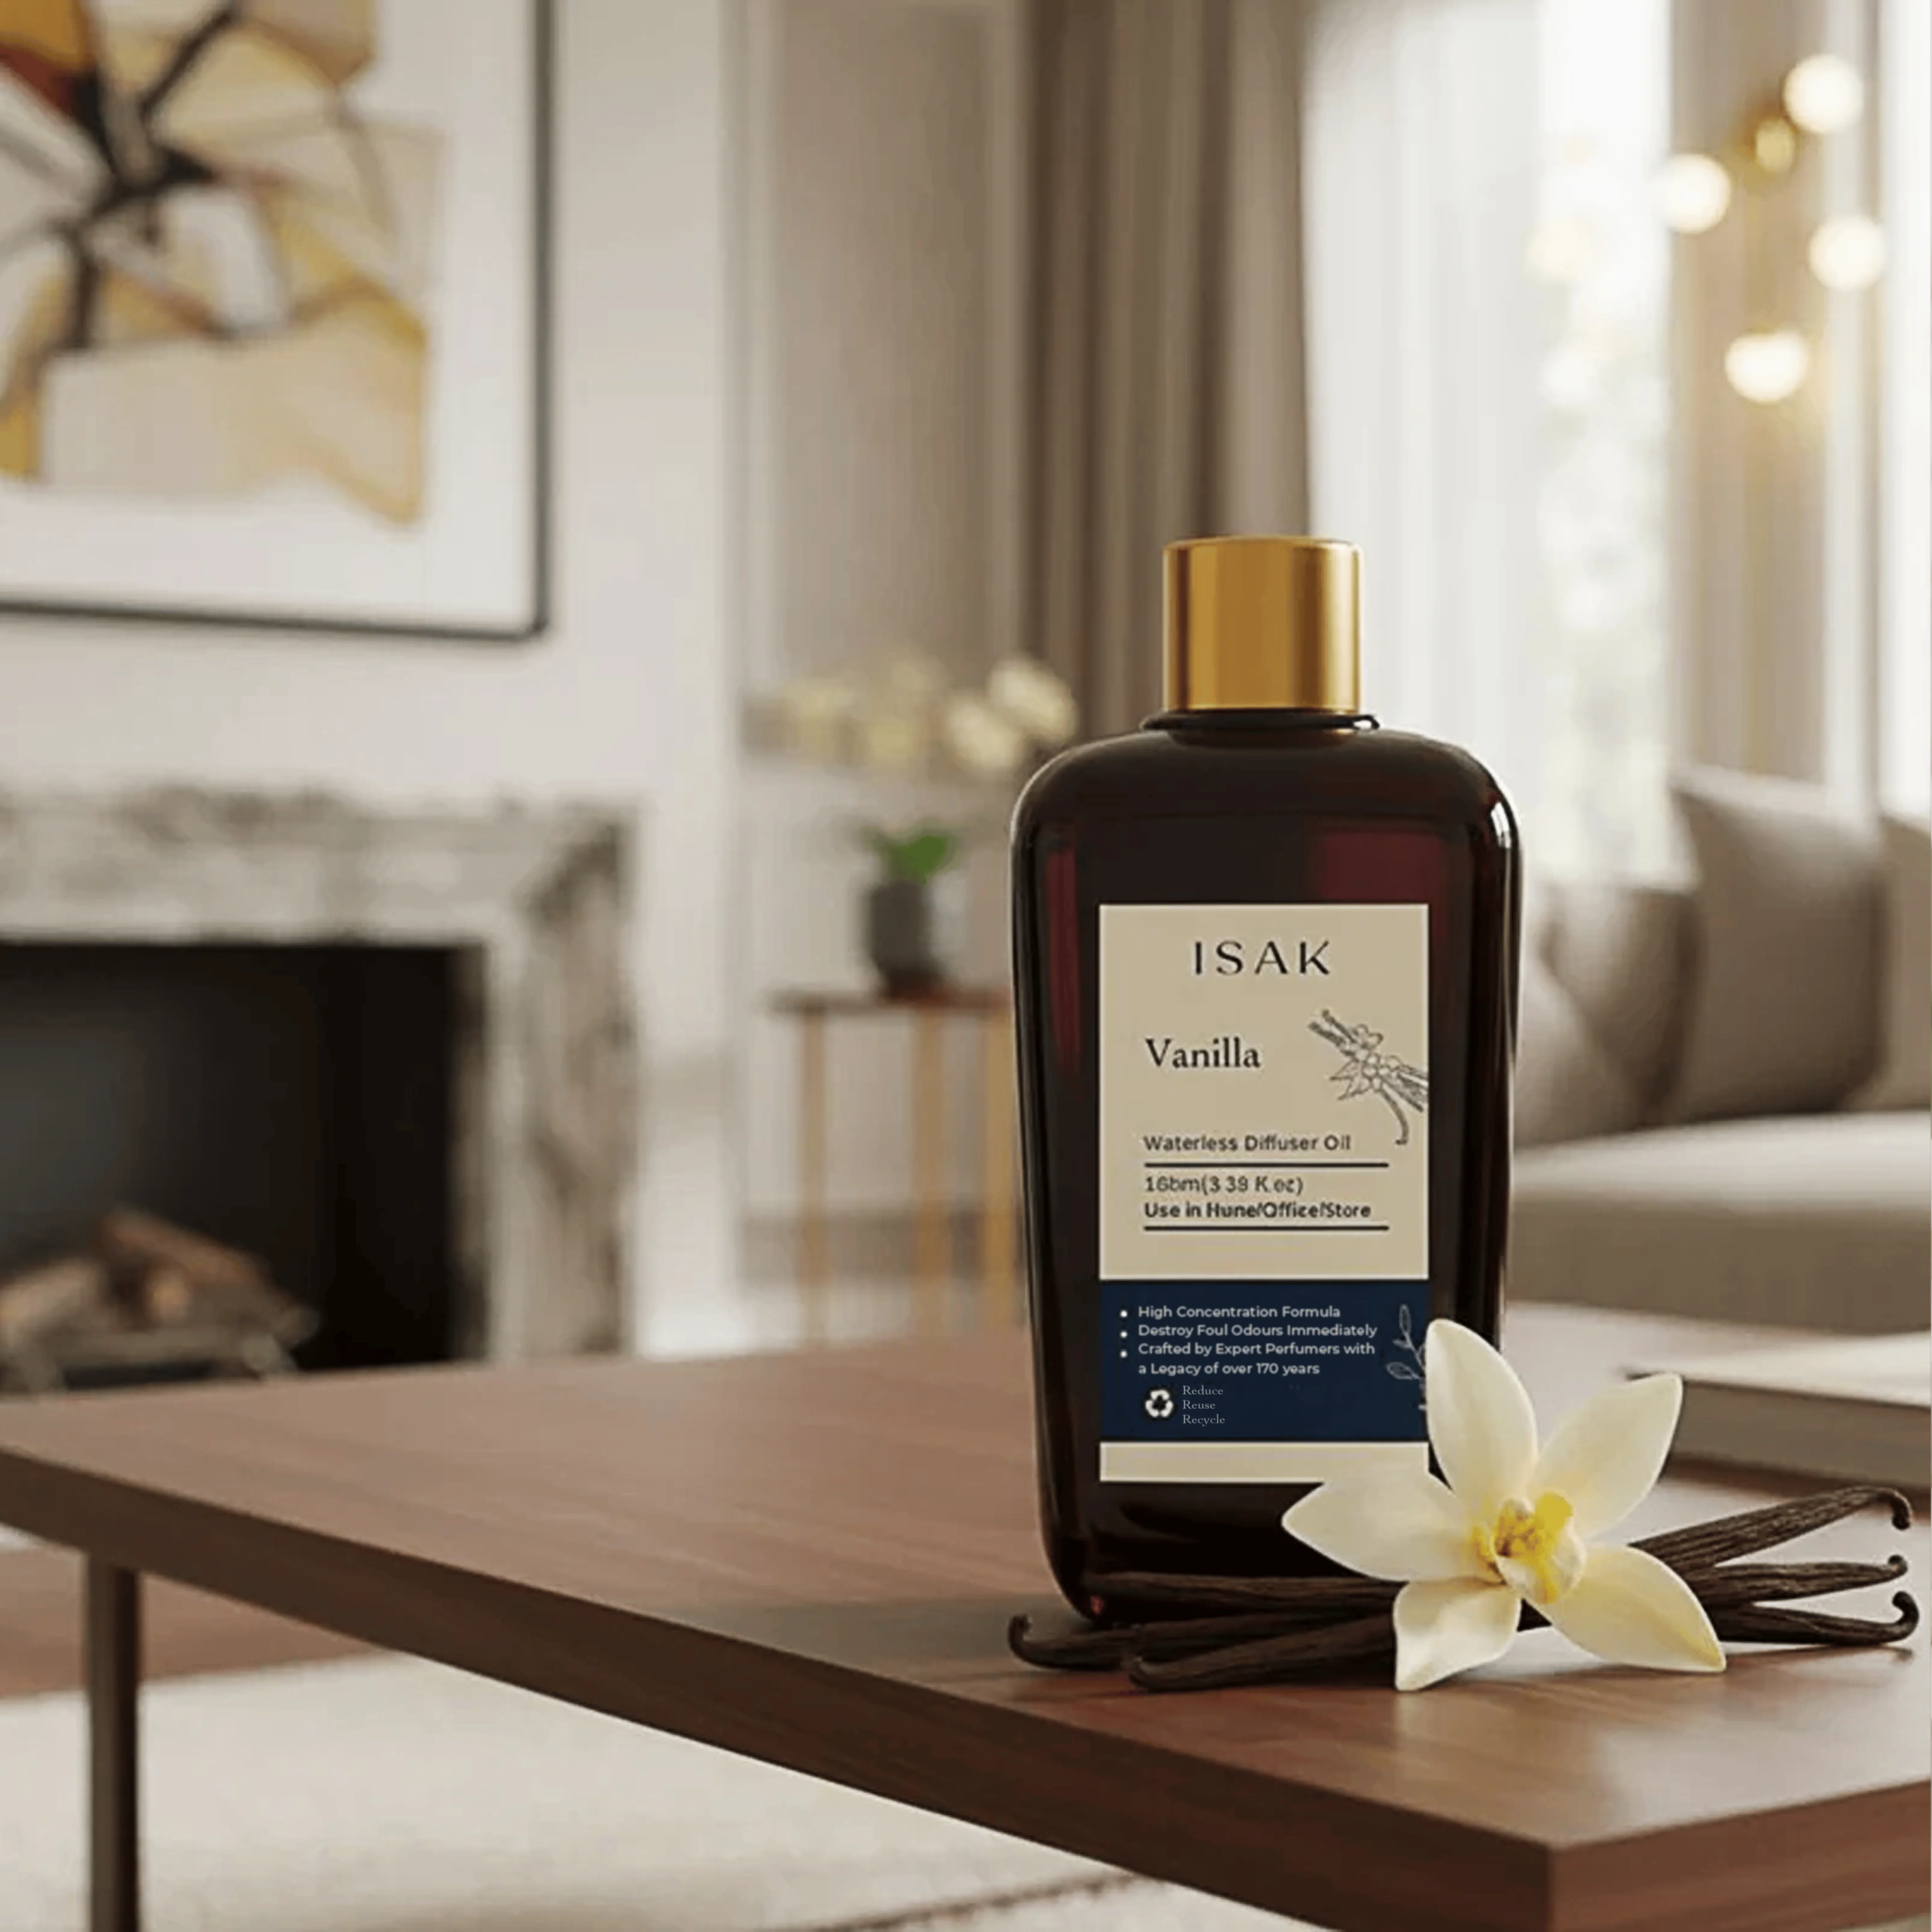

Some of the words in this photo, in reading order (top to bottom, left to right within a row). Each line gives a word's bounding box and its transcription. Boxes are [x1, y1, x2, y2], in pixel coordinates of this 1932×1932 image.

[1194, 940, 1330, 976] ISAK
[1145, 1036, 1261, 1069] Vanilla
[1143, 1135, 1238, 1151] Waterless
[1244, 1134, 1318, 1151] Diffuser
[1324, 1134, 1351, 1151] Oil
[1144, 1202, 1181, 1218] Use
[1185, 1201, 1202, 1218] in
[1138, 1304, 1173, 1320] High
[1176, 1304, 1278, 1318] Concentration
[1281, 1304, 1341, 1318] Formula
[1138, 1324, 1194, 1339] Destroy
[1196, 1323, 1228, 1336] Foul
[1230, 1323, 1284, 1336] Odours
[1286, 1323, 1378, 1338] Immediately
[1138, 1341, 1192, 1355] Crafted
[1194, 1342, 1213, 1357] by
[1215, 1342, 1262, 1357] Expert
[1265, 1342, 1341, 1355] Perfumers
[1343, 1342, 1376, 1355] with
[1138, 1365, 1147, 1374] a
[1150, 1362, 1202, 1376] Legacy
[1204, 1361, 1220, 1374] of
[1221, 1364, 1253, 1374] over
[1256, 1362, 1279, 1374] 170
[1282, 1364, 1321, 1377] years
[1182, 1385, 1224, 1395] Reduce
[1182, 1400, 1216, 1410] Reuse
[1182, 1413, 1226, 1427] Recycle
